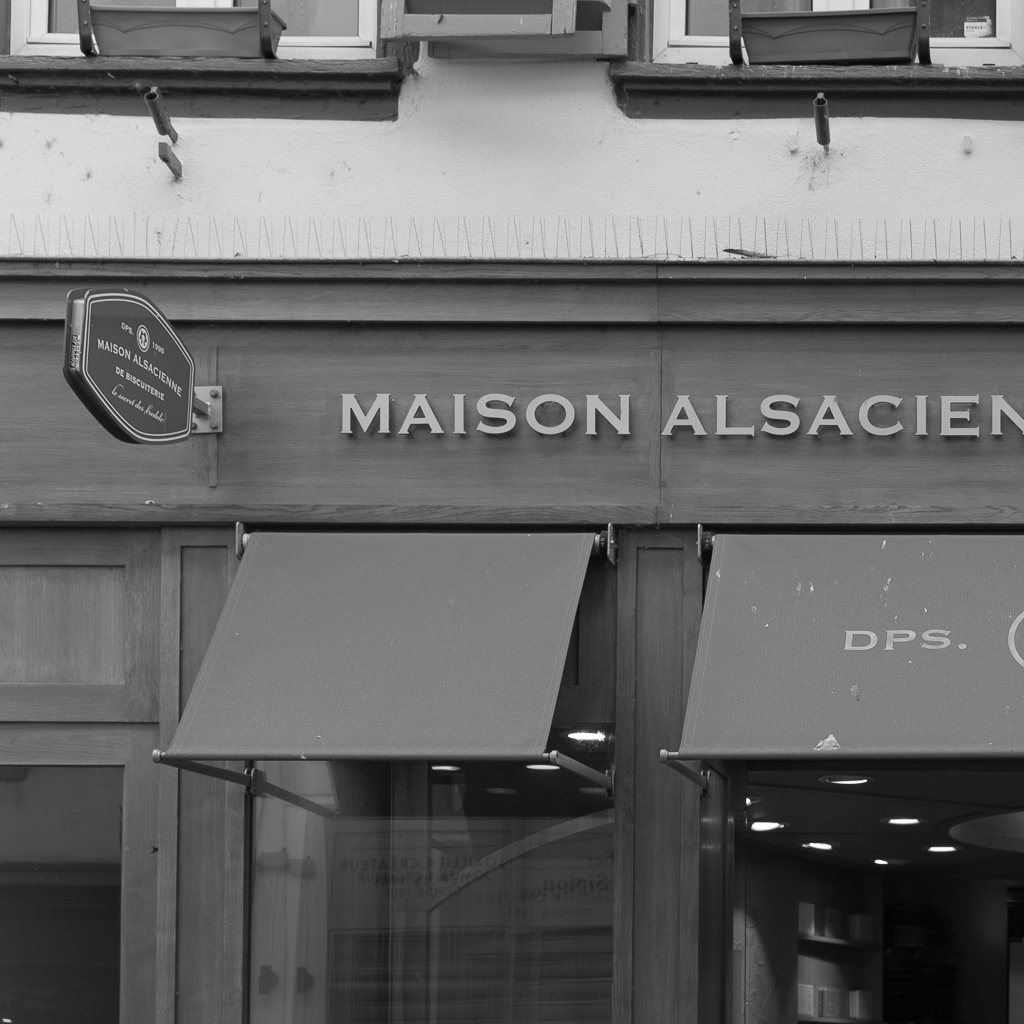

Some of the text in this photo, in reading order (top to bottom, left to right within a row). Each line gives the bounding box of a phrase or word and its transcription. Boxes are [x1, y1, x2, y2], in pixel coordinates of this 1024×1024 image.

[121, 322, 165, 355] DPS. 1996
[97, 338, 131, 360] MAISON
[133, 354, 183, 397] ALSACIENNE
[115, 366, 165, 401] DE BISCUITERIE
[134, 400, 144, 412] des
[341, 392, 630, 436] MAISON
[843, 629, 968, 651] DPS.
